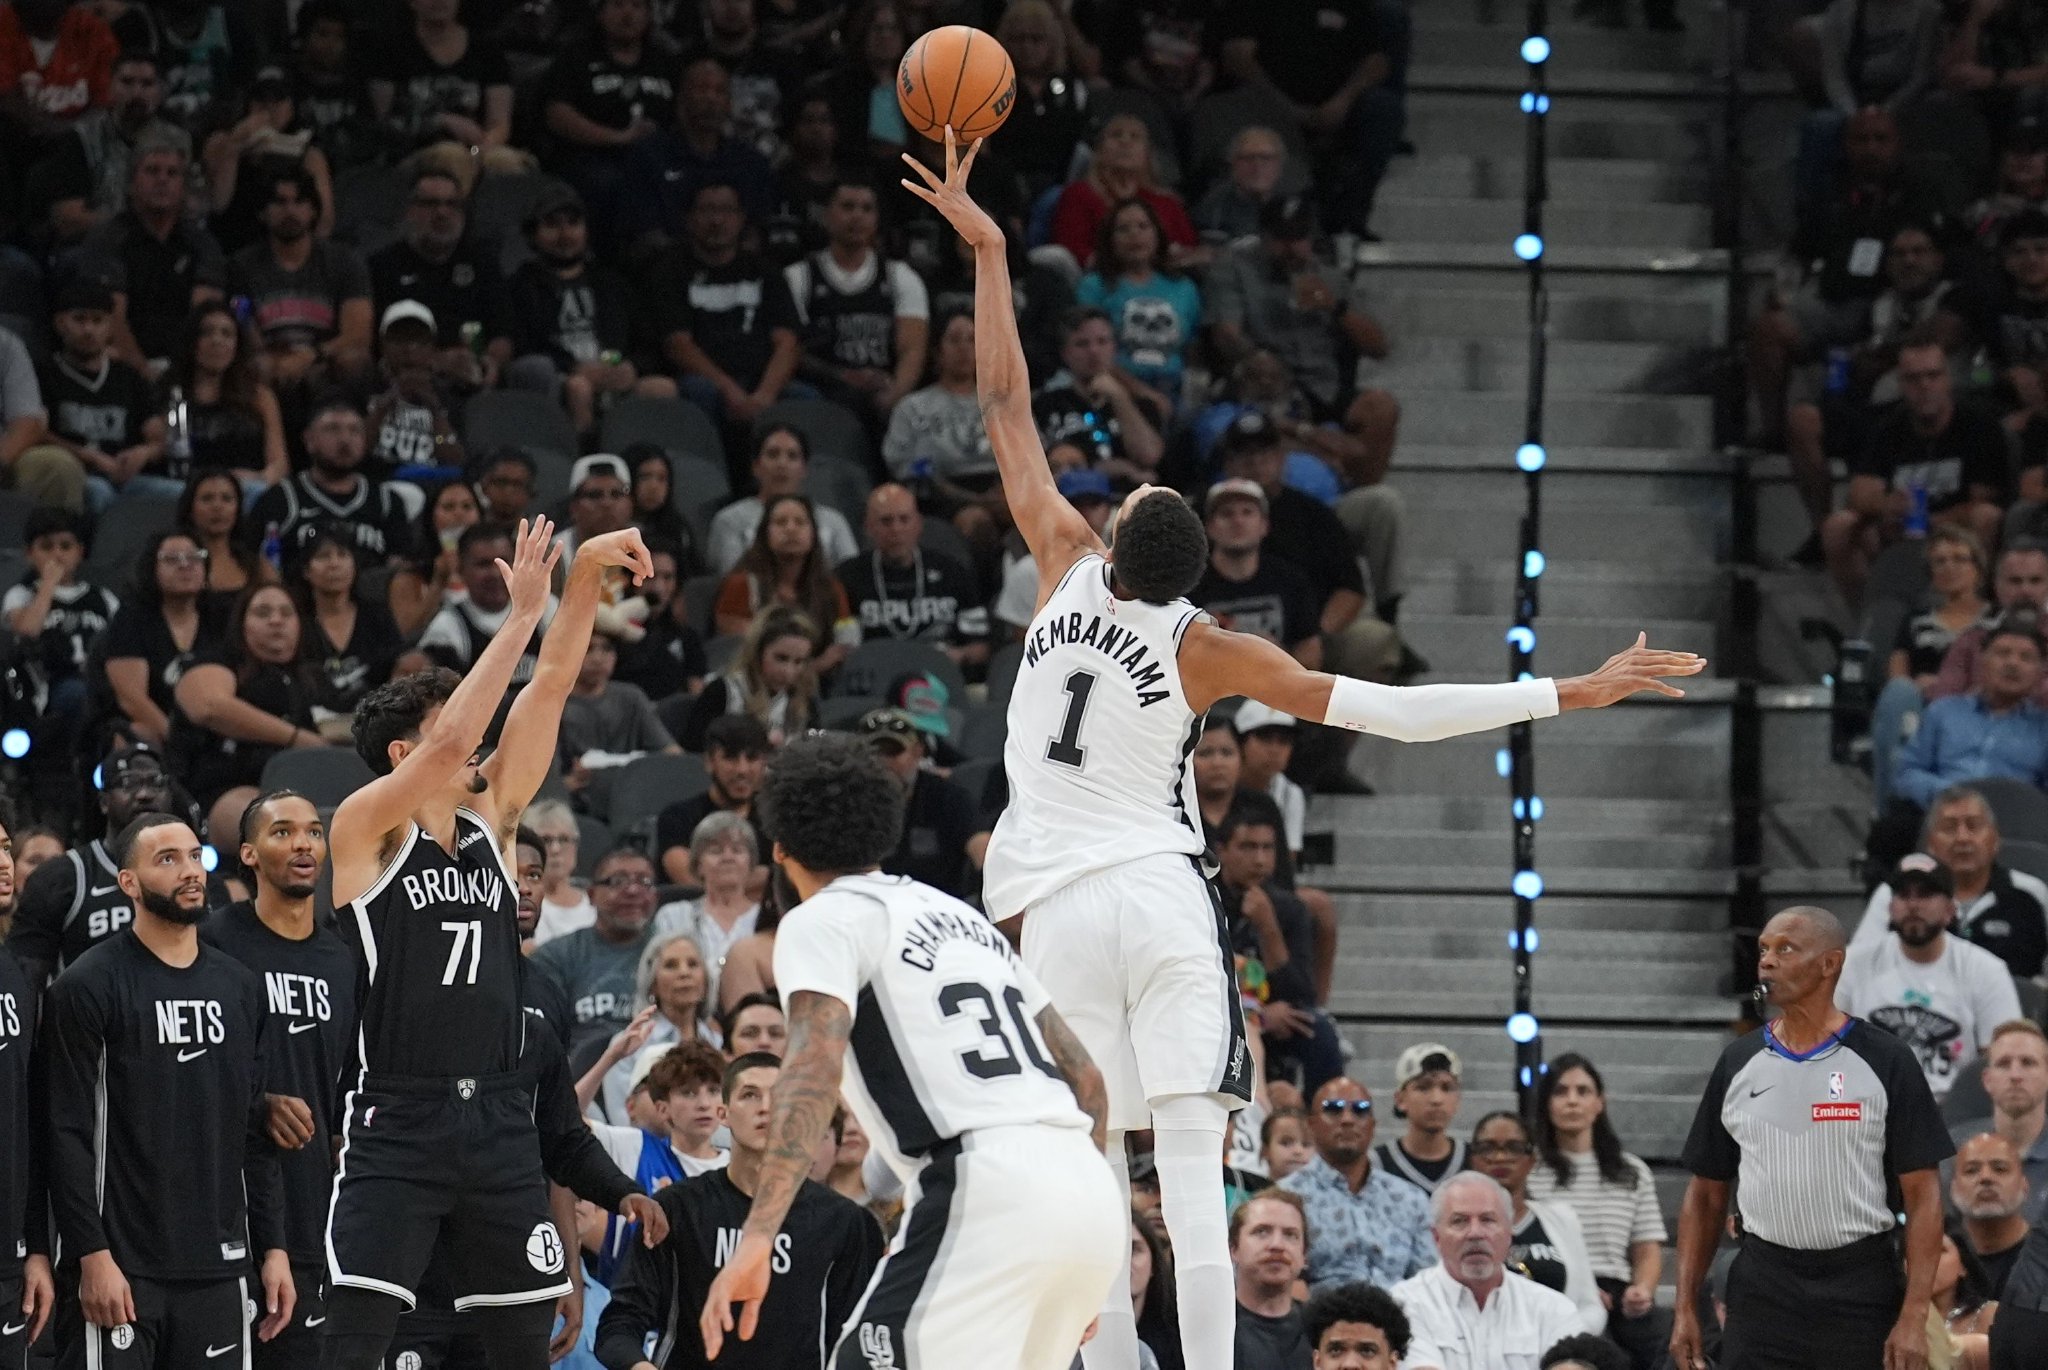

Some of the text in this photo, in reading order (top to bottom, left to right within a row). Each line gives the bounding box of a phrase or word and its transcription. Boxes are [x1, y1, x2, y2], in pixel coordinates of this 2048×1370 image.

[1026, 612, 1171, 708] WEMBANYAMA
[1043, 667, 1100, 773] 1
[441, 920, 482, 986] 71
[901, 911, 1014, 972] CHAMPAGN
[155, 1000, 225, 1044] NETS
[265, 971, 331, 1022] NETS
[1812, 1106, 1860, 1118] Emirates
[714, 1227, 792, 1274] NS
